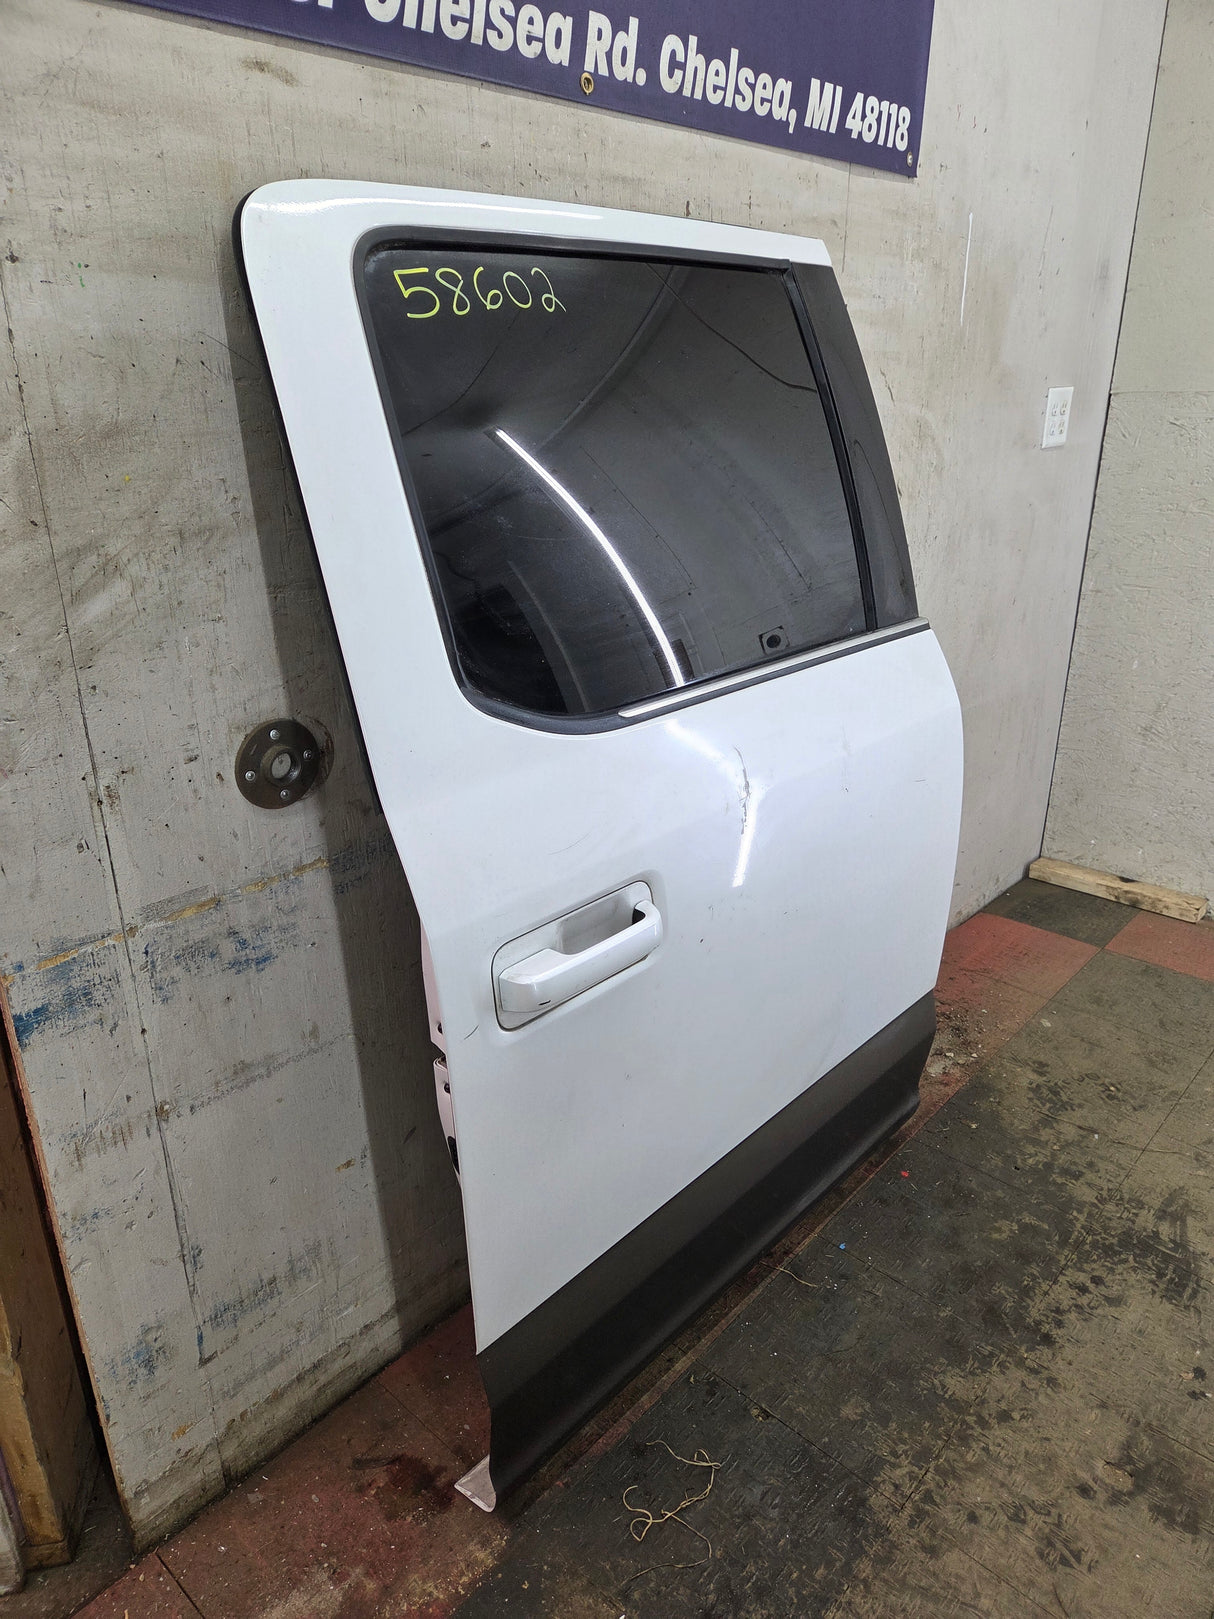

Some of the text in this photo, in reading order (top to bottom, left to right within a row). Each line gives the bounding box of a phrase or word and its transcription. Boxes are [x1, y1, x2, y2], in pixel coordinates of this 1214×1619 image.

[583, 10, 647, 87] Rd.
[659, 33, 797, 134] Chelsea,
[803, 77, 843, 134] MI
[844, 91, 911, 152] 48118
[393, 266, 567, 319] 58602
